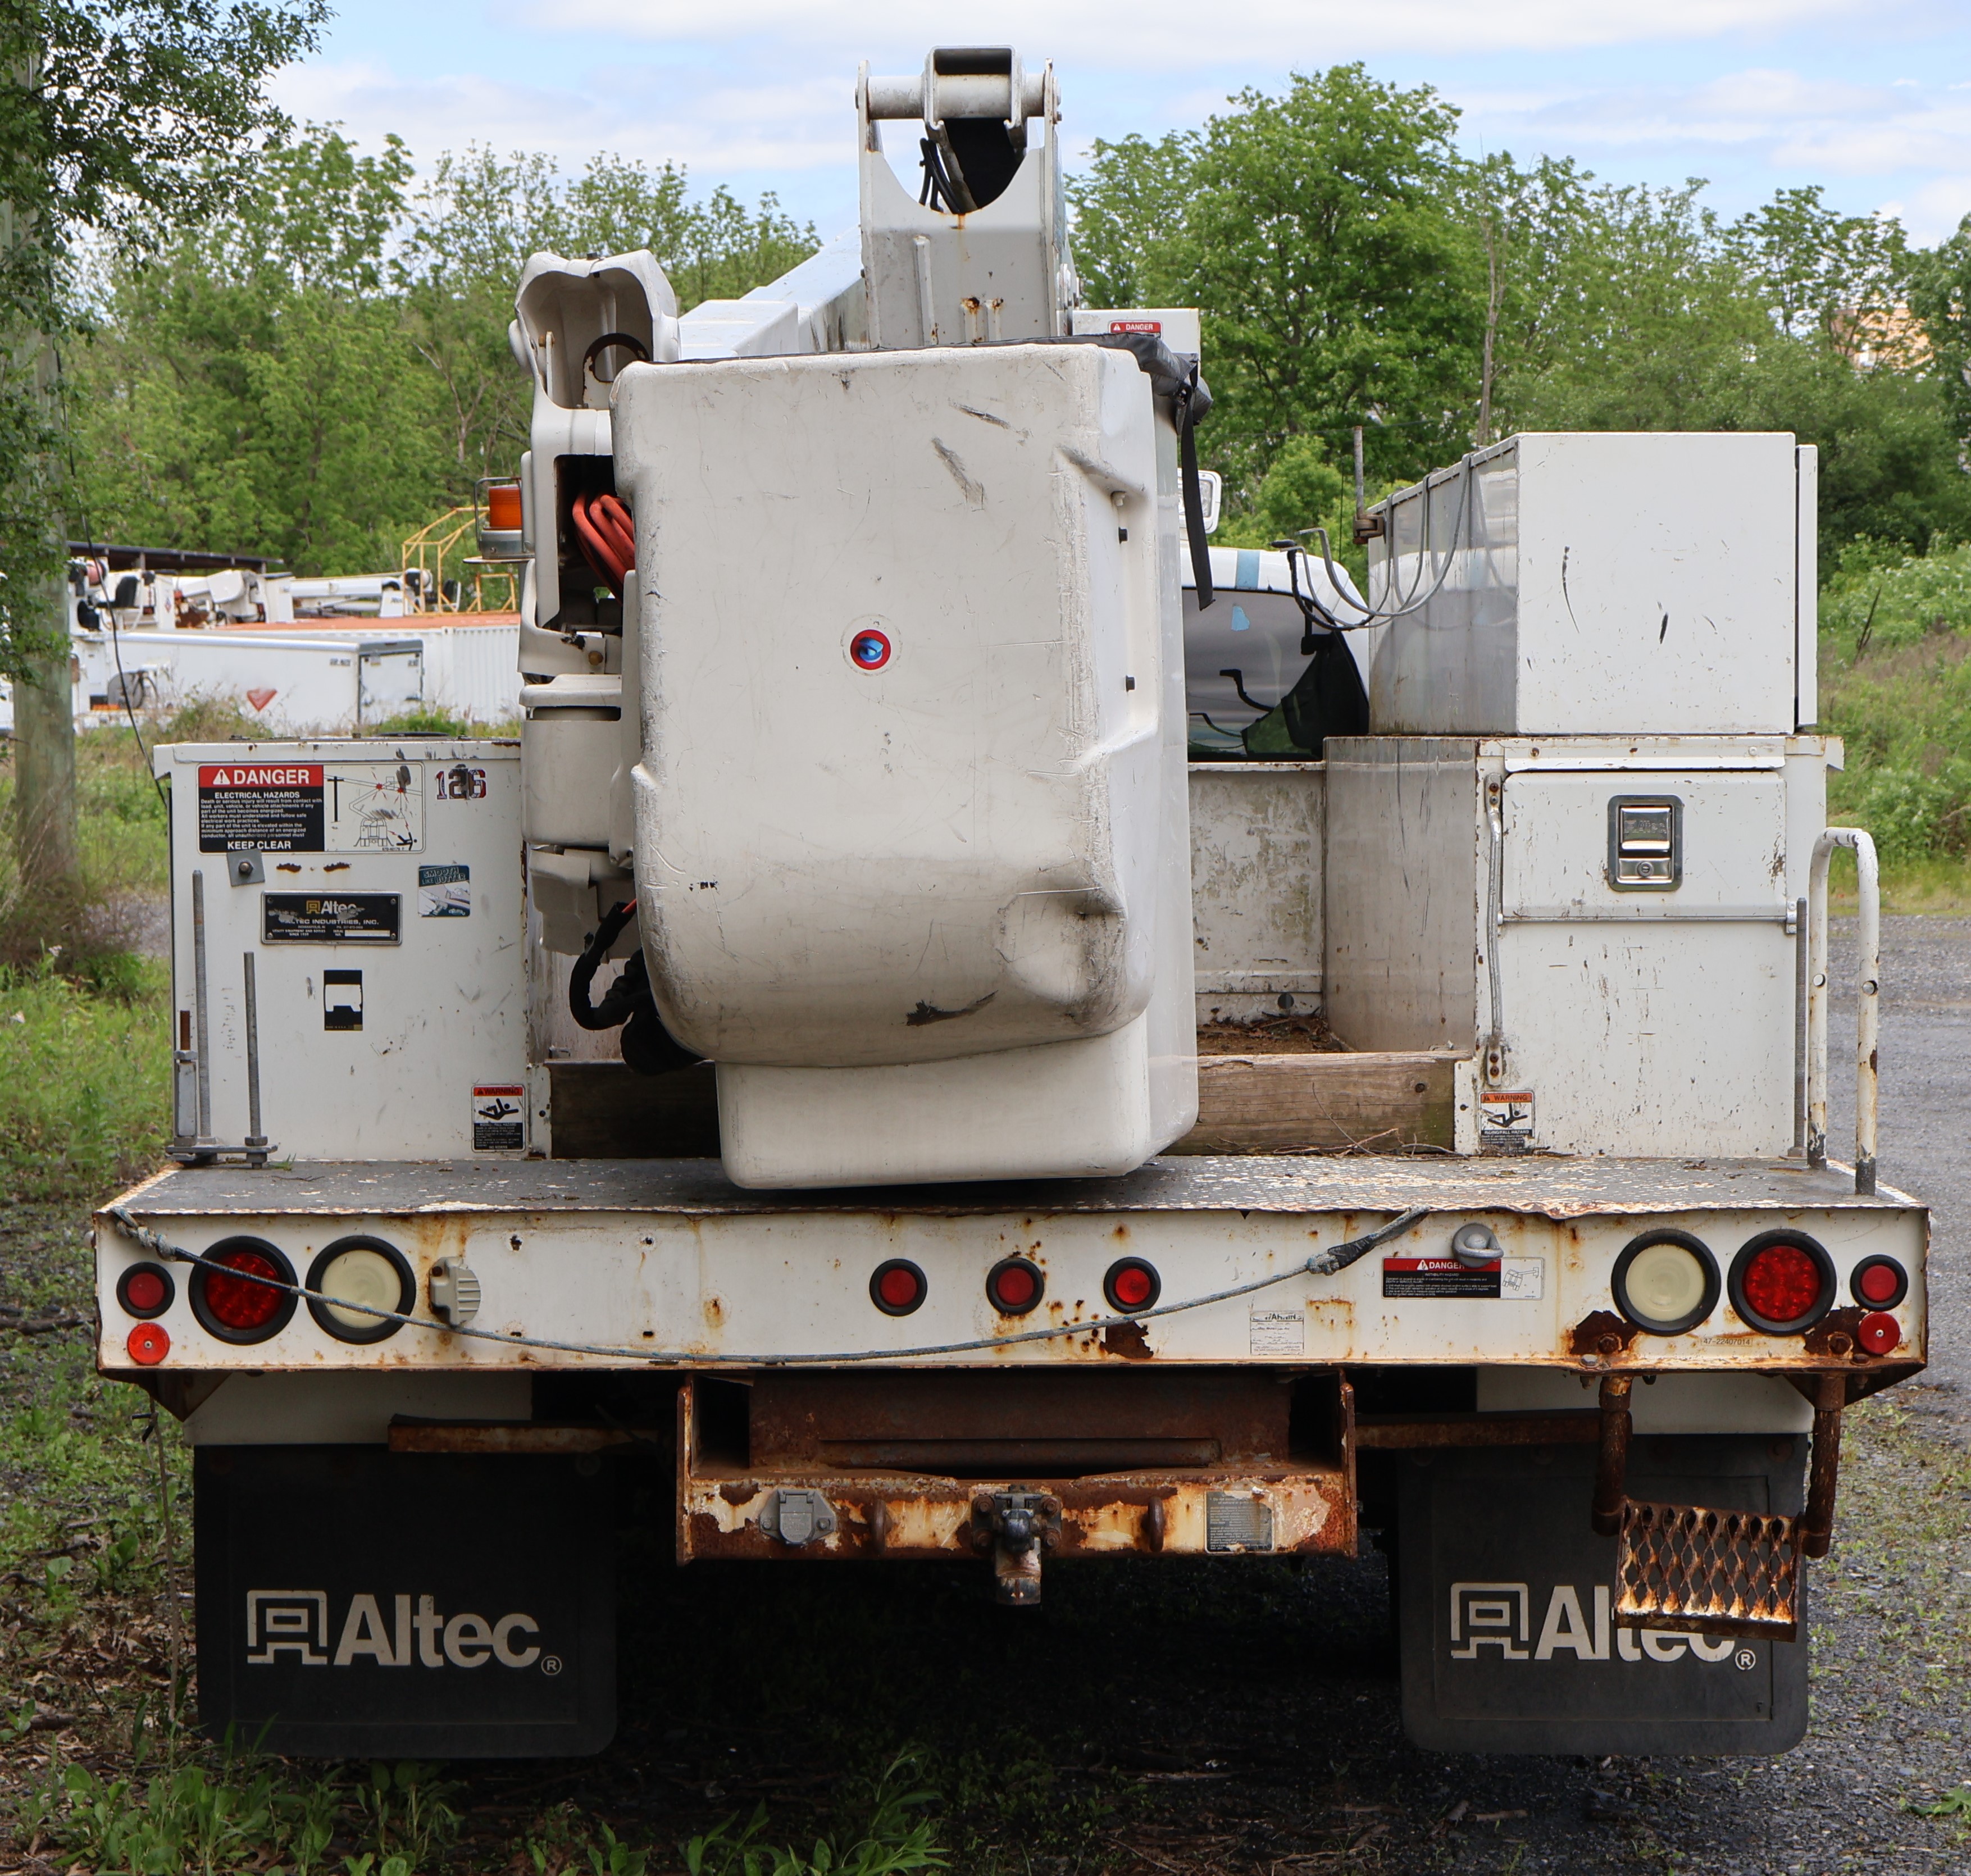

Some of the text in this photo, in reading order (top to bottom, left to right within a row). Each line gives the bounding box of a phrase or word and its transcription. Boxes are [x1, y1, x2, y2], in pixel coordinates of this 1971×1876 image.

[234, 769, 310, 785] DANGER
[436, 768, 486, 800] 126
[227, 840, 292, 850] KEEP CLEAR
[423, 867, 459, 878] SMOOTH
[435, 873, 466, 884] BUTTER
[321, 900, 357, 915] Altec
[334, 1594, 540, 1668] Altec
